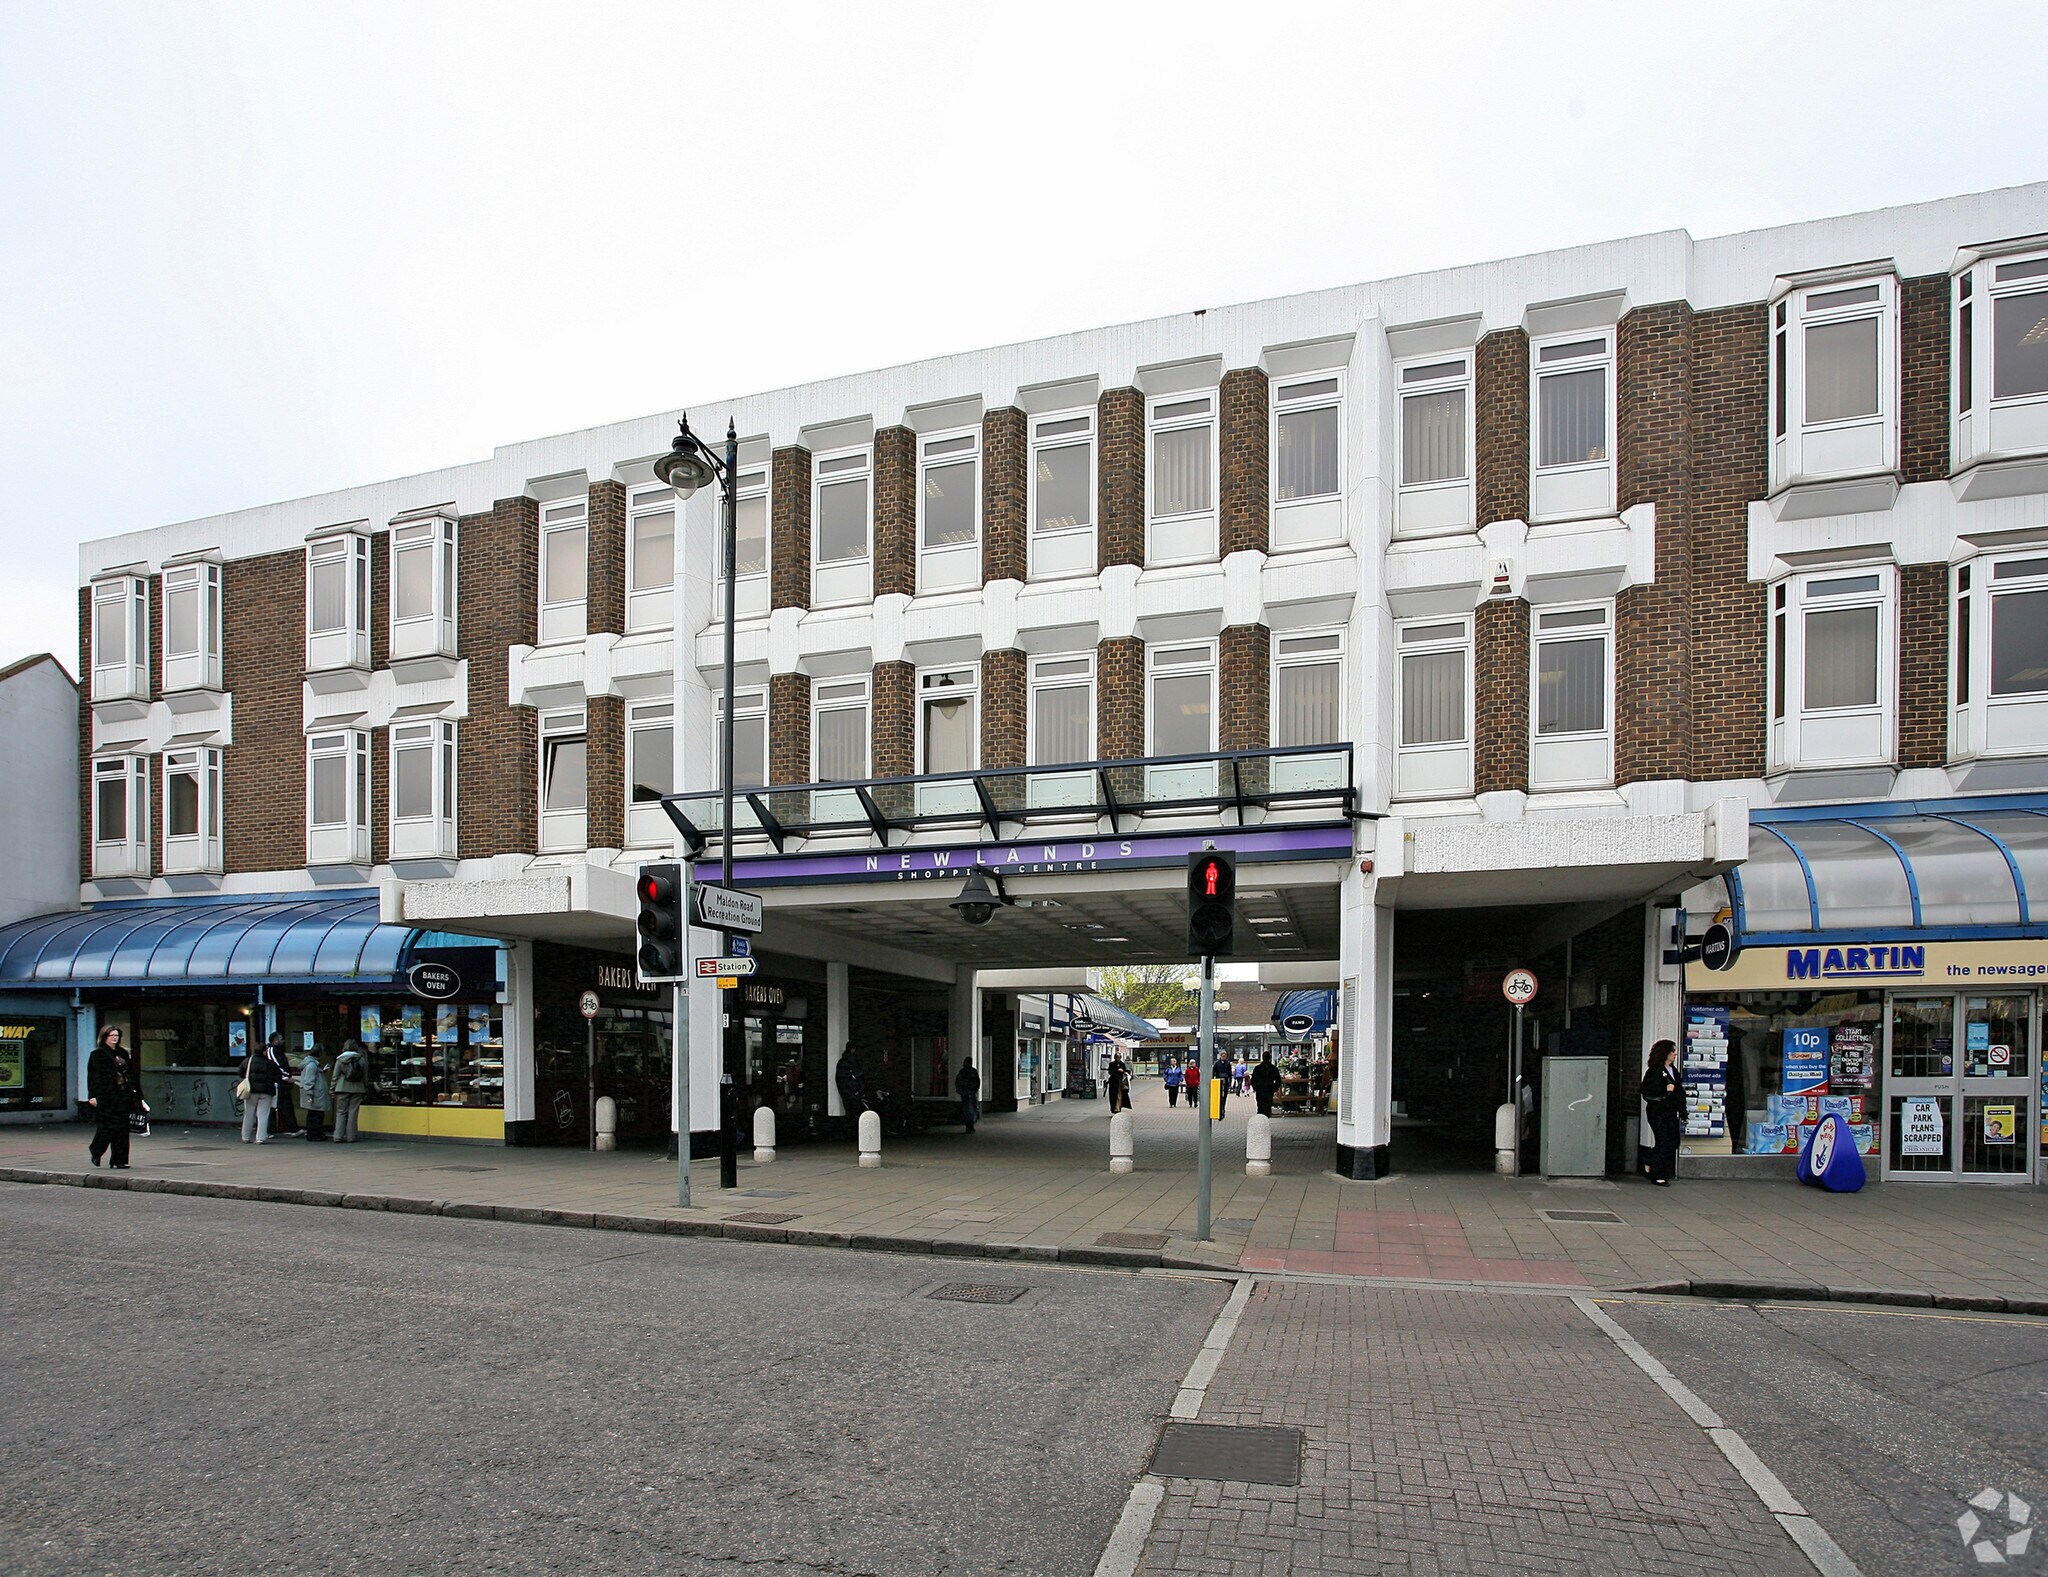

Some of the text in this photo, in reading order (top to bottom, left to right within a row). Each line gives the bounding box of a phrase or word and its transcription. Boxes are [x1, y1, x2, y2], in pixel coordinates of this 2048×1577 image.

[866, 841, 1132, 871] NEWLANDS
[897, 861, 1097, 880] SHOPPIG CENTRE
[716, 894, 754, 912] Maldon Road
[707, 907, 761, 927] Recreation Ground
[1705, 940, 1726, 955] MARTINS
[718, 963, 747, 971] Station
[1787, 946, 1924, 980] MARTIN
[422, 971, 450, 982] BAKERS
[598, 965, 631, 989] BAKERS
[1946, 965, 2048, 977] the newsage
[426, 981, 446, 990] OVEN
[745, 985, 767, 1002] BAKERS
[1793, 1032, 1820, 1048] 10p
[1835, 1034, 1872, 1042] COLLECTING!
[1915, 1104, 1931, 1112] CAR
[1913, 1114, 1933, 1122] PARK
[1823, 1122, 1835, 1132] play
[1910, 1124, 1935, 1132] PLANS
[1903, 1134, 1942, 1142] SCRAPPED
